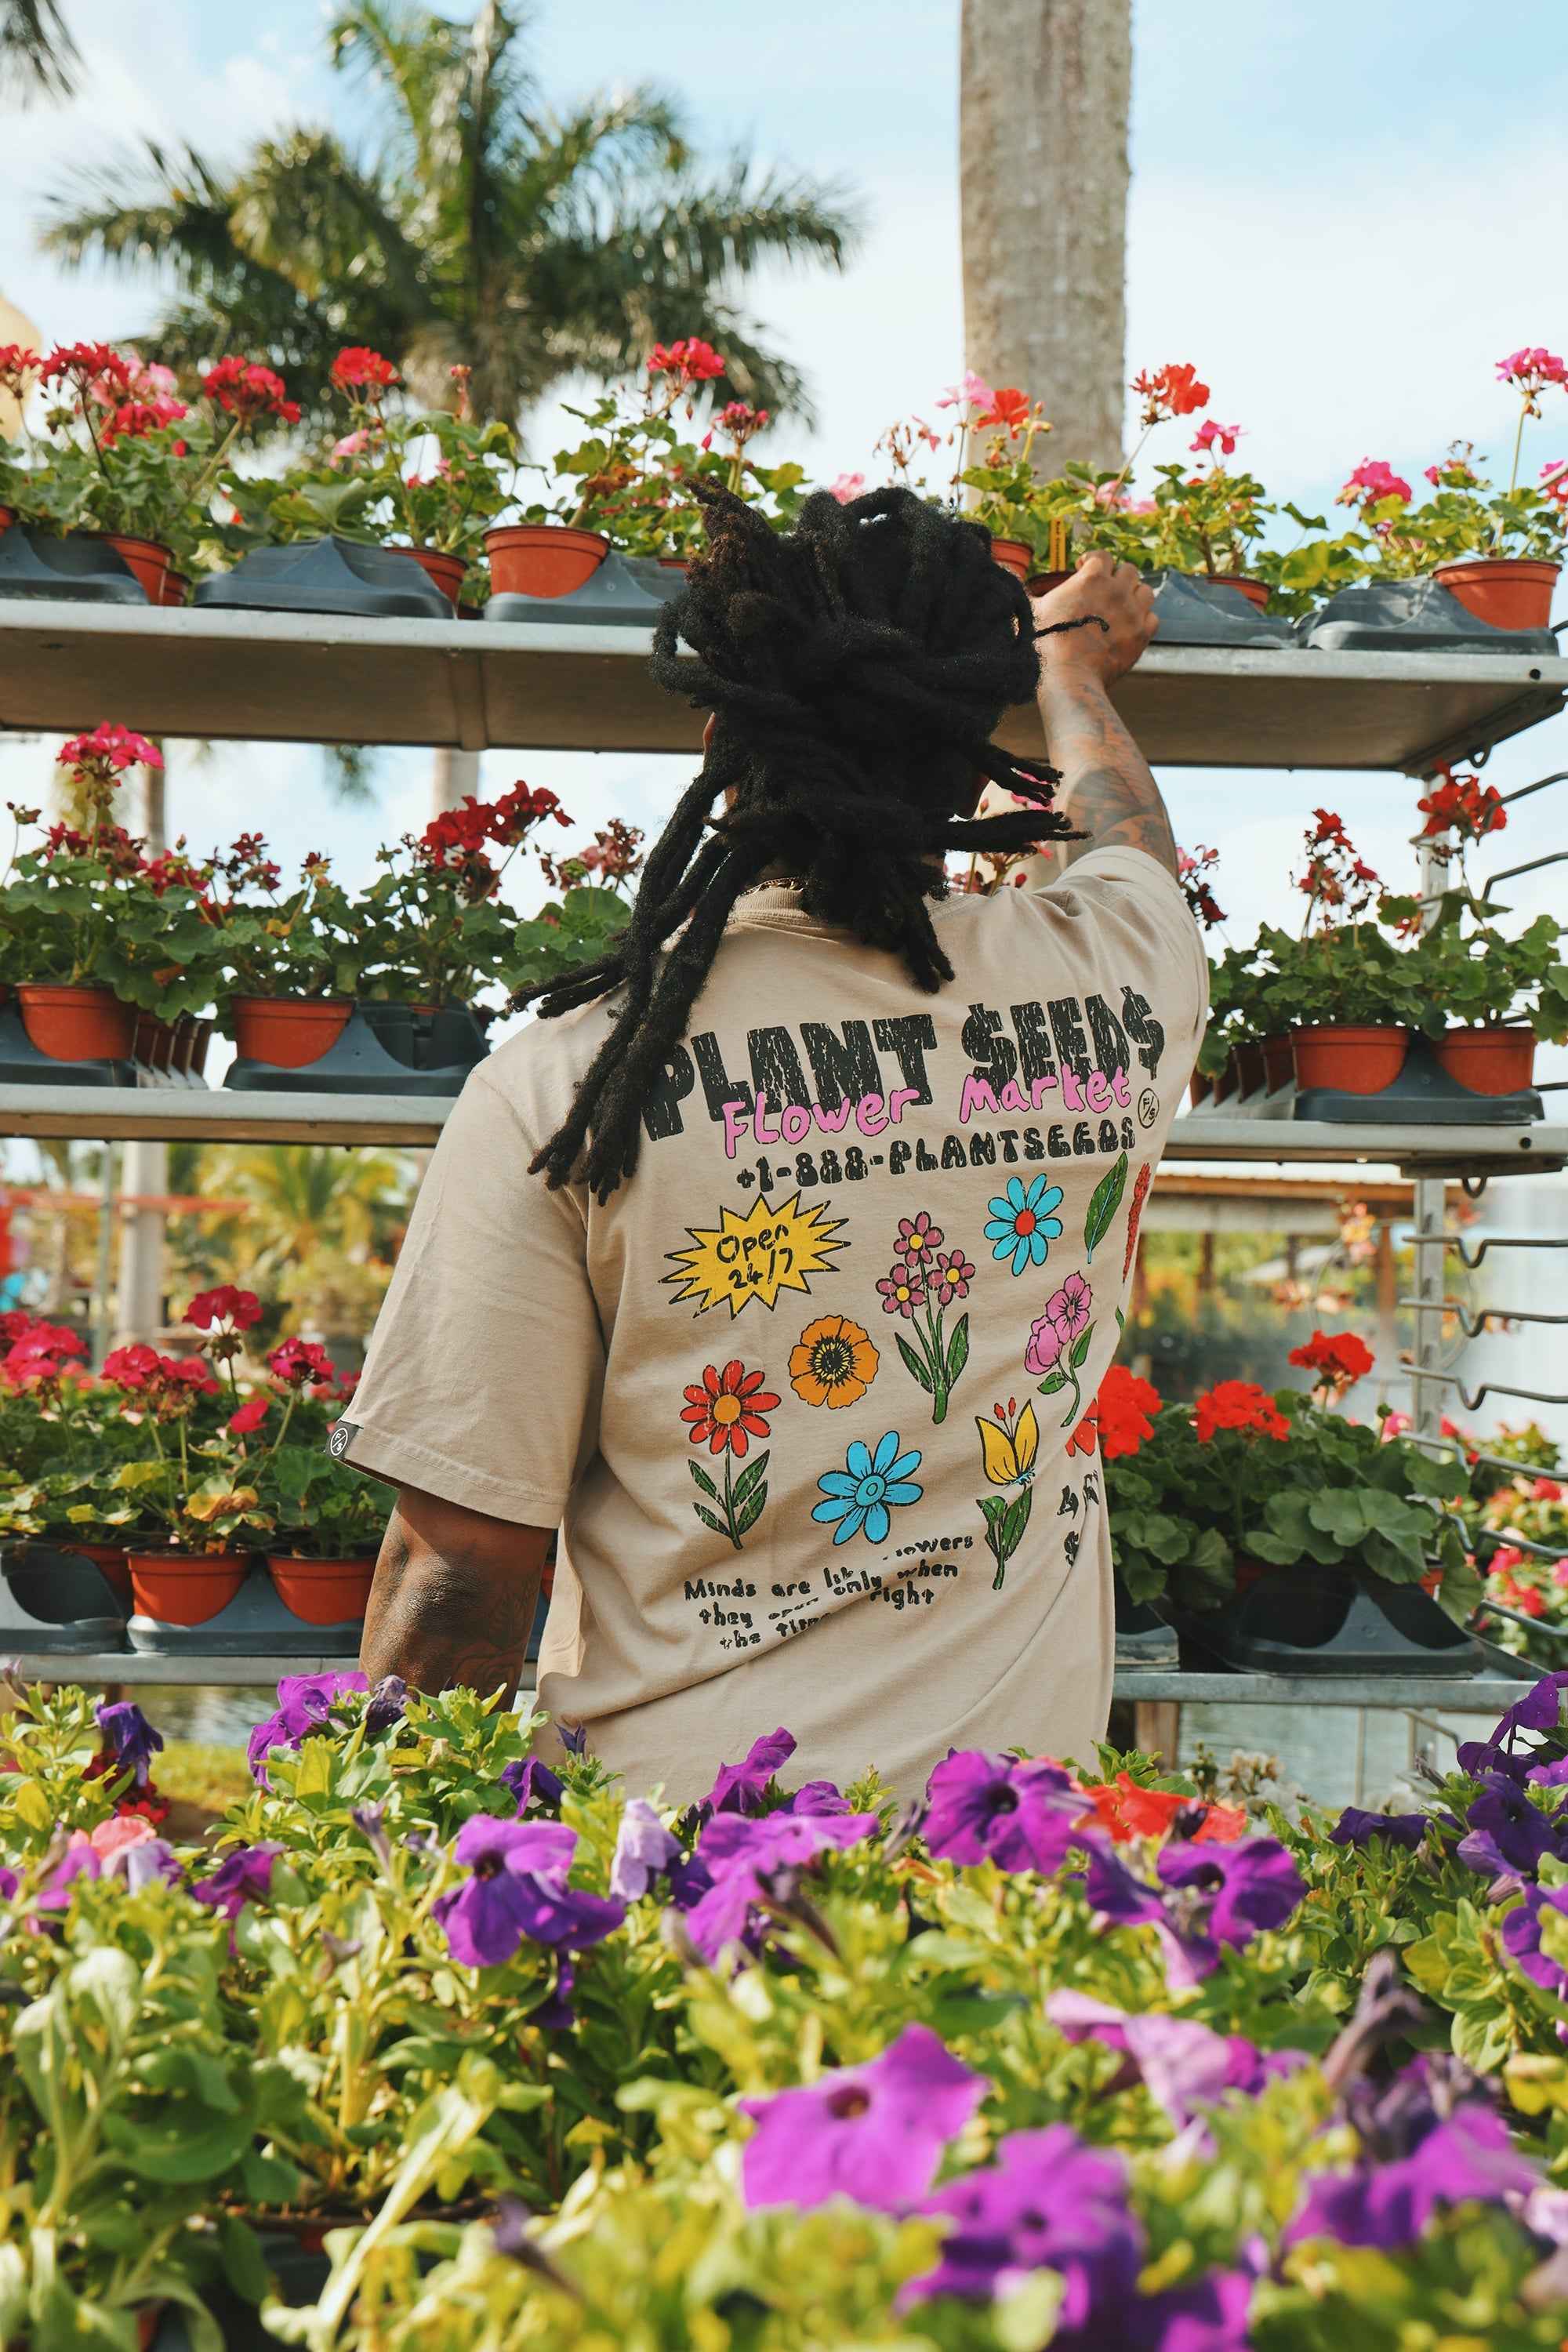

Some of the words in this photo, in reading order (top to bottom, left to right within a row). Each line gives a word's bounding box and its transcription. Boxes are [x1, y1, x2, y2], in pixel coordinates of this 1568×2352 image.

[717, 1224, 789, 1263] Open
[728, 1247, 793, 1288] 24/7
[684, 1578, 757, 1600] Minds
[771, 1581, 811, 1596] are
[699, 1602, 753, 1628] they
[833, 1570, 882, 1595] only
[720, 1630, 760, 1650] the
[870, 1581, 935, 1610] right
